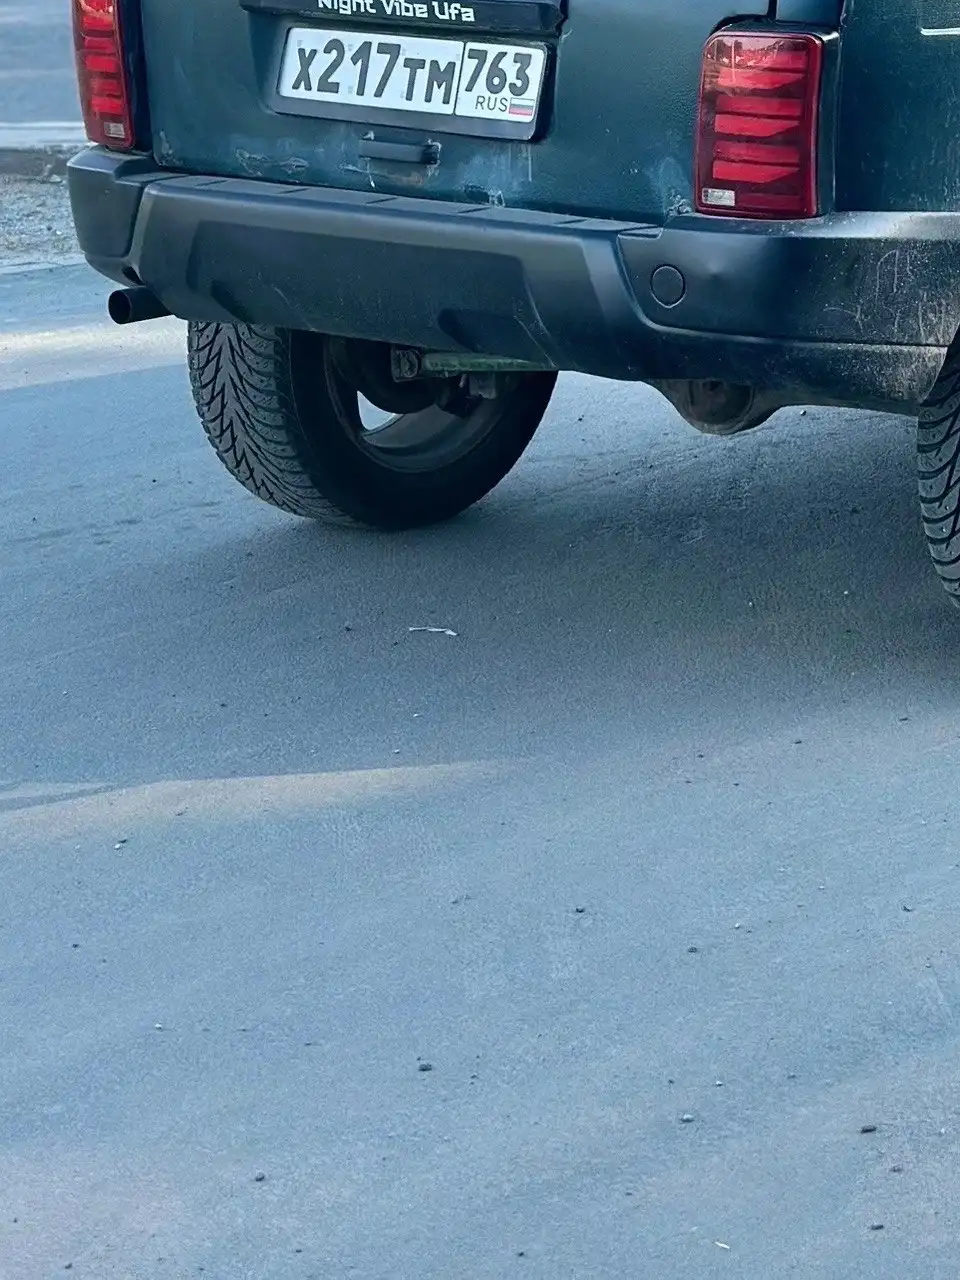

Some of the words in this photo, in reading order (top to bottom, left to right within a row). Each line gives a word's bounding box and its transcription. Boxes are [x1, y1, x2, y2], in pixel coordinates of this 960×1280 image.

[432, 0, 475, 22] Ufa
[465, 48, 532, 96] 763
[475, 95, 508, 112] RUS
